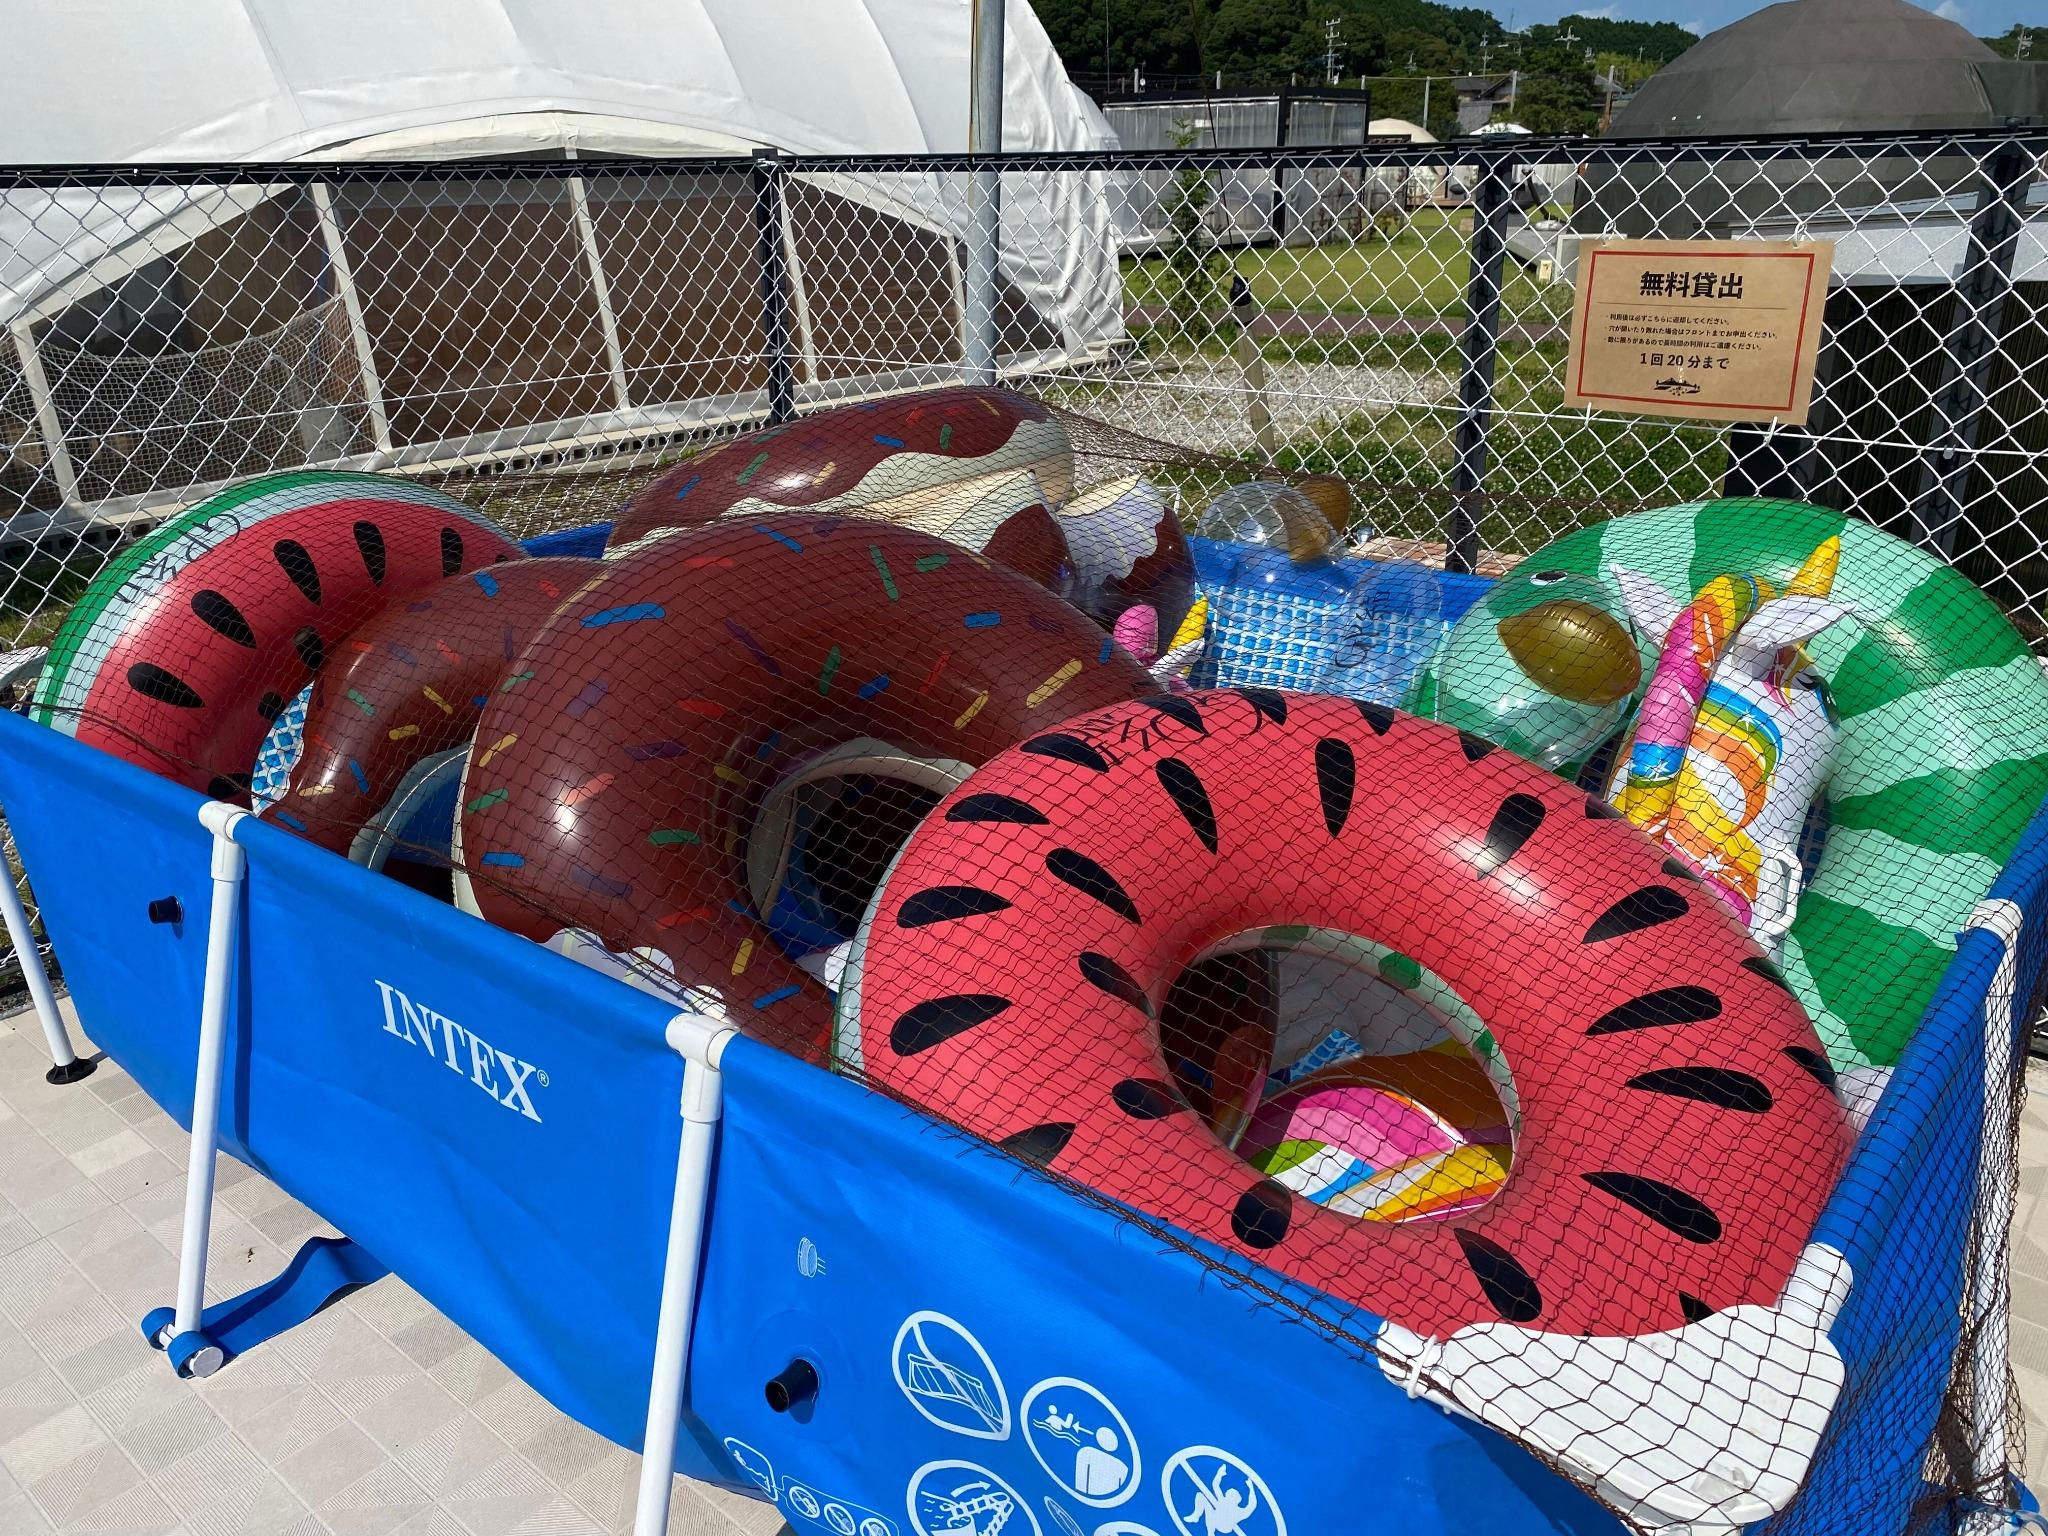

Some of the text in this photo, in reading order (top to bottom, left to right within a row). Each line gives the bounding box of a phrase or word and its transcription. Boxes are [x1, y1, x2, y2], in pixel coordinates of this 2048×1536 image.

[1640, 271, 1743, 299] 無料貸出
[1639, 352, 1730, 370] 1回20分まで
